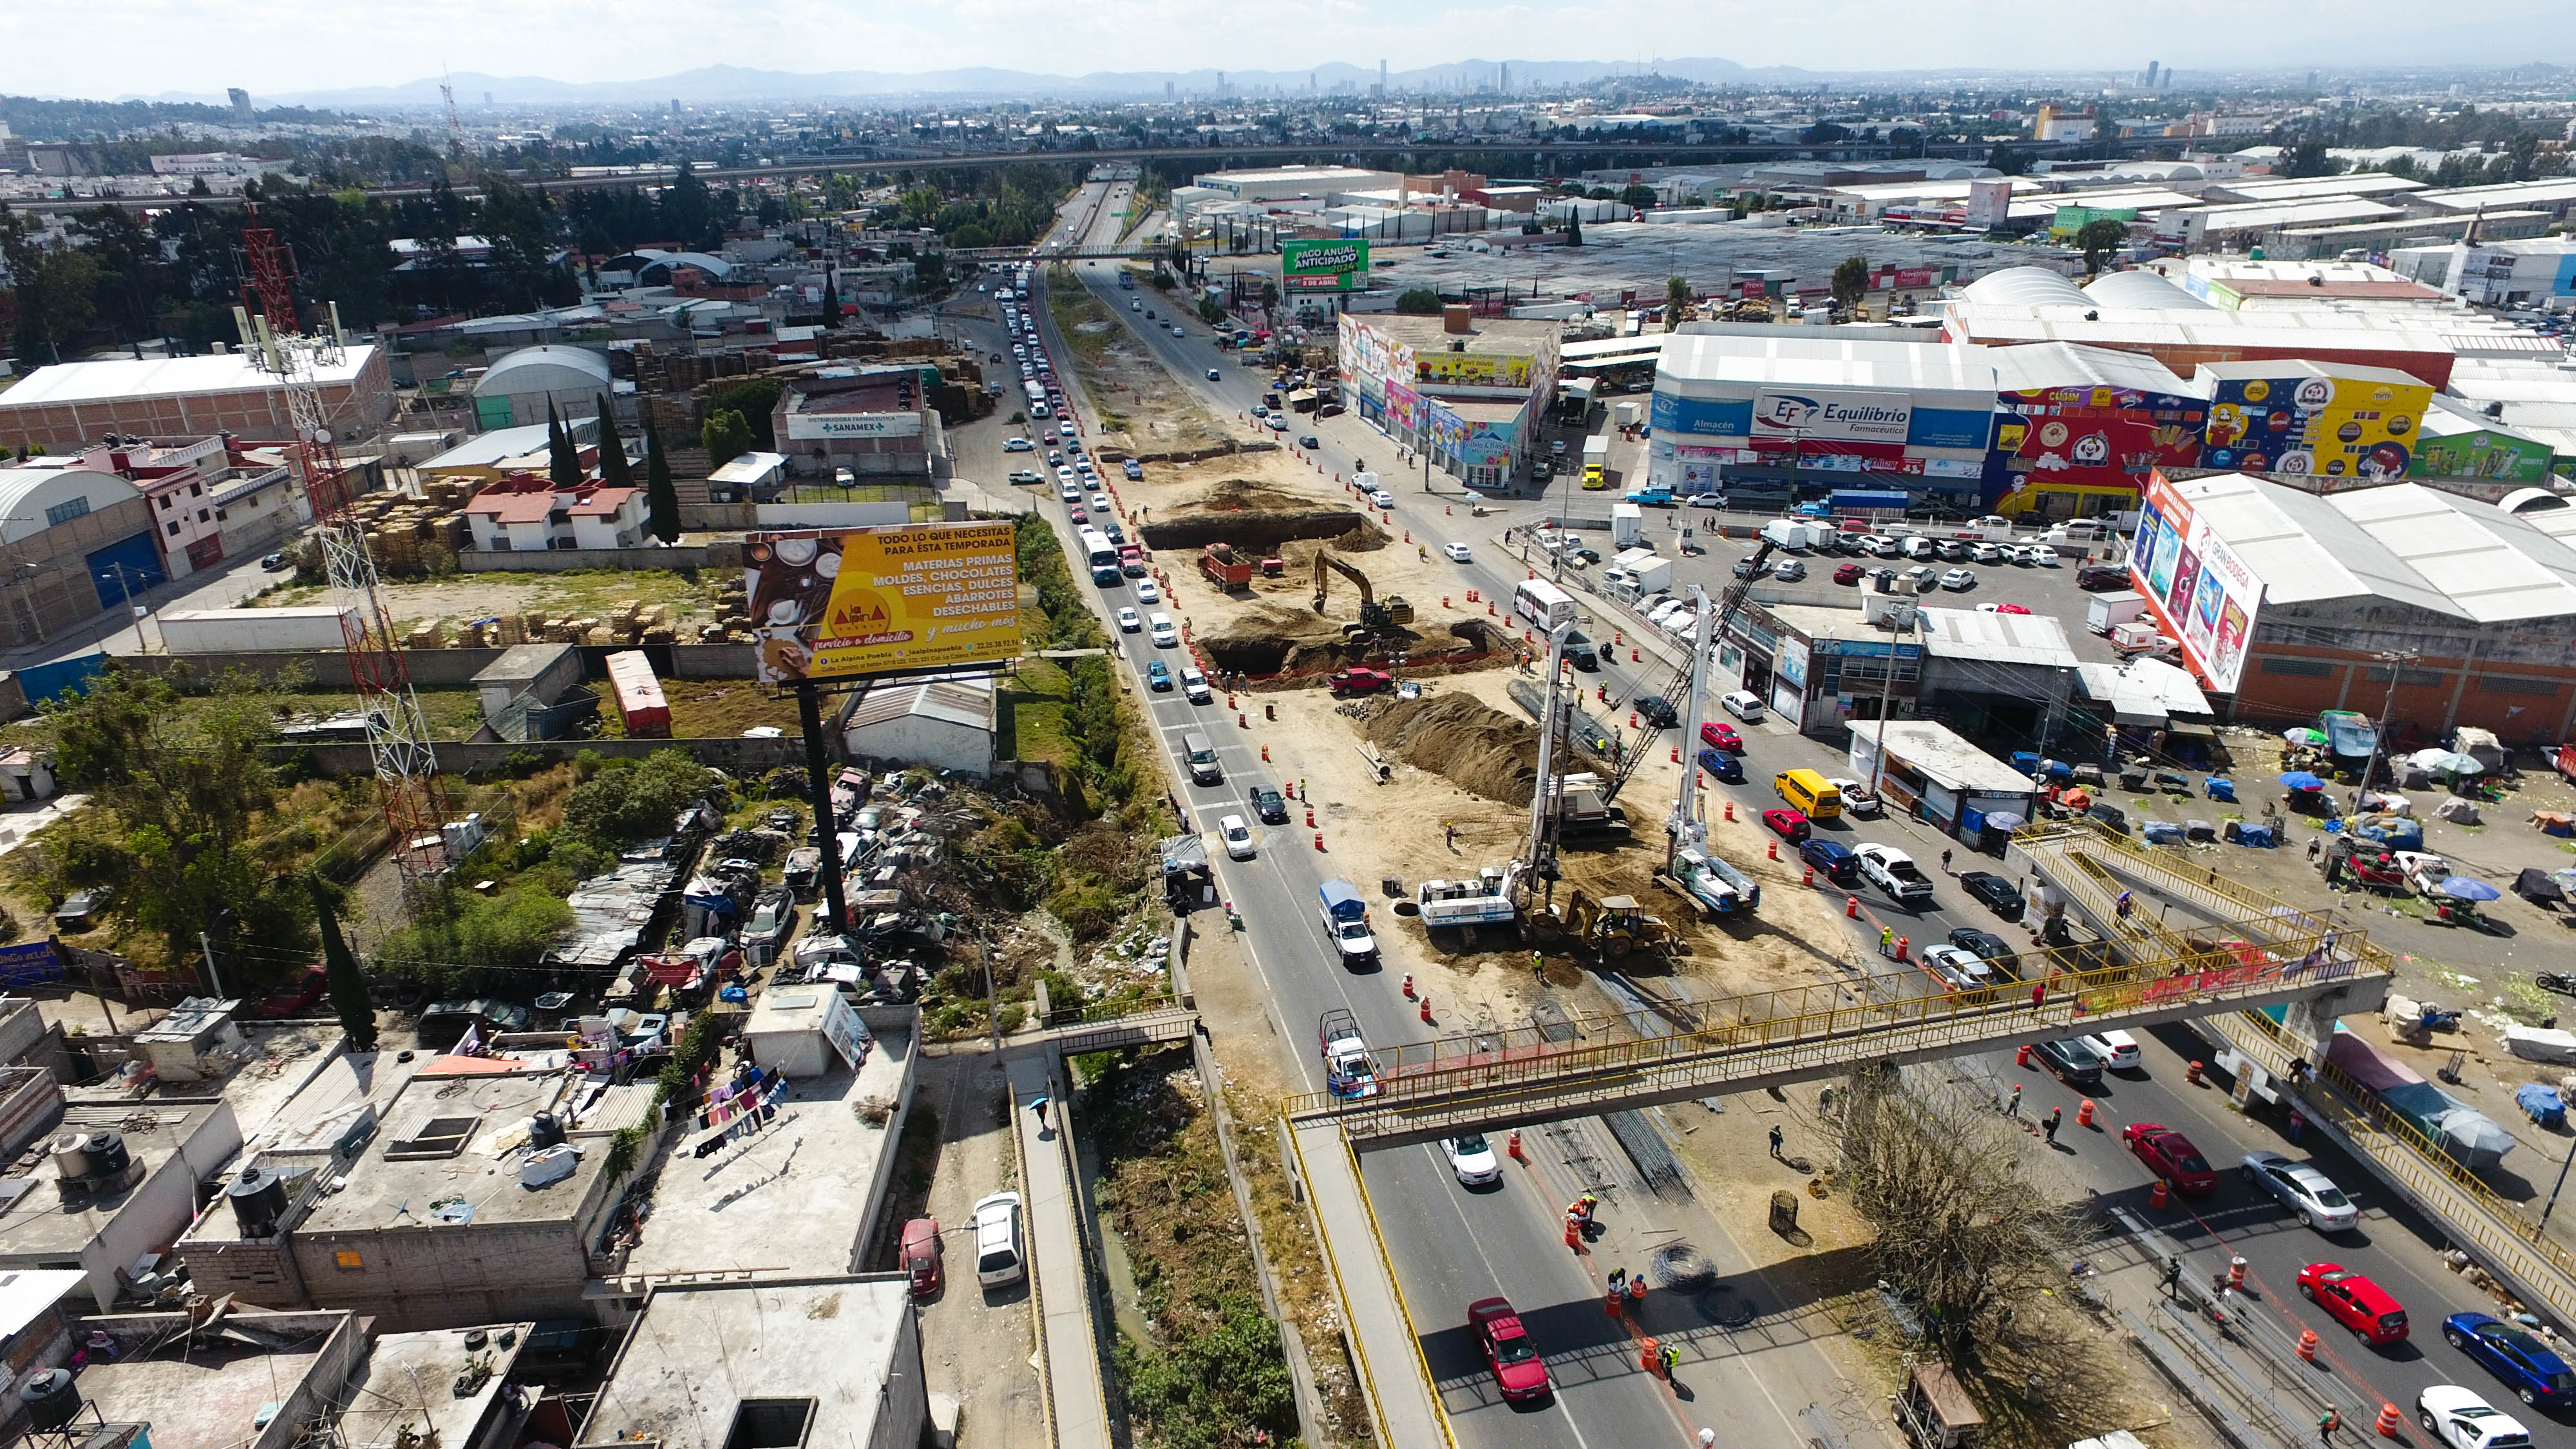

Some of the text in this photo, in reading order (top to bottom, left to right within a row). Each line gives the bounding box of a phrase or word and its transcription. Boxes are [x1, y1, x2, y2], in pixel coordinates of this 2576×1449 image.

[1296, 245, 1356, 259] PAGO ANUAL
[1294, 253, 1356, 269] ANTICIPADO
[1331, 262, 1355, 273] 2024
[1824, 403, 1907, 423] Equilibrio
[833, 424, 875, 432] SANAMEX
[1694, 419, 1734, 430] Almacén
[877, 527, 1010, 545] TODO LO QUE NECESITAS
[884, 538, 1010, 555] PARA ÉSTA TEMPORADA
[903, 554, 1013, 573] MATERIAS PRIMAS
[2213, 541, 2228, 565] GRAN
[2226, 555, 2249, 591] BODEGA
[873, 565, 1014, 587] MOLDES, CHOCOLATES
[903, 577, 1014, 596] ESENCIAS, DULCES
[945, 589, 1015, 604] ABARROTES
[933, 601, 1016, 618] DESECHABLES
[839, 623, 883, 631] PUEBLA
[926, 627, 938, 643] y
[942, 618, 986, 634] mucho
[813, 636, 853, 652] servicio
[864, 630, 913, 644] domicilio
